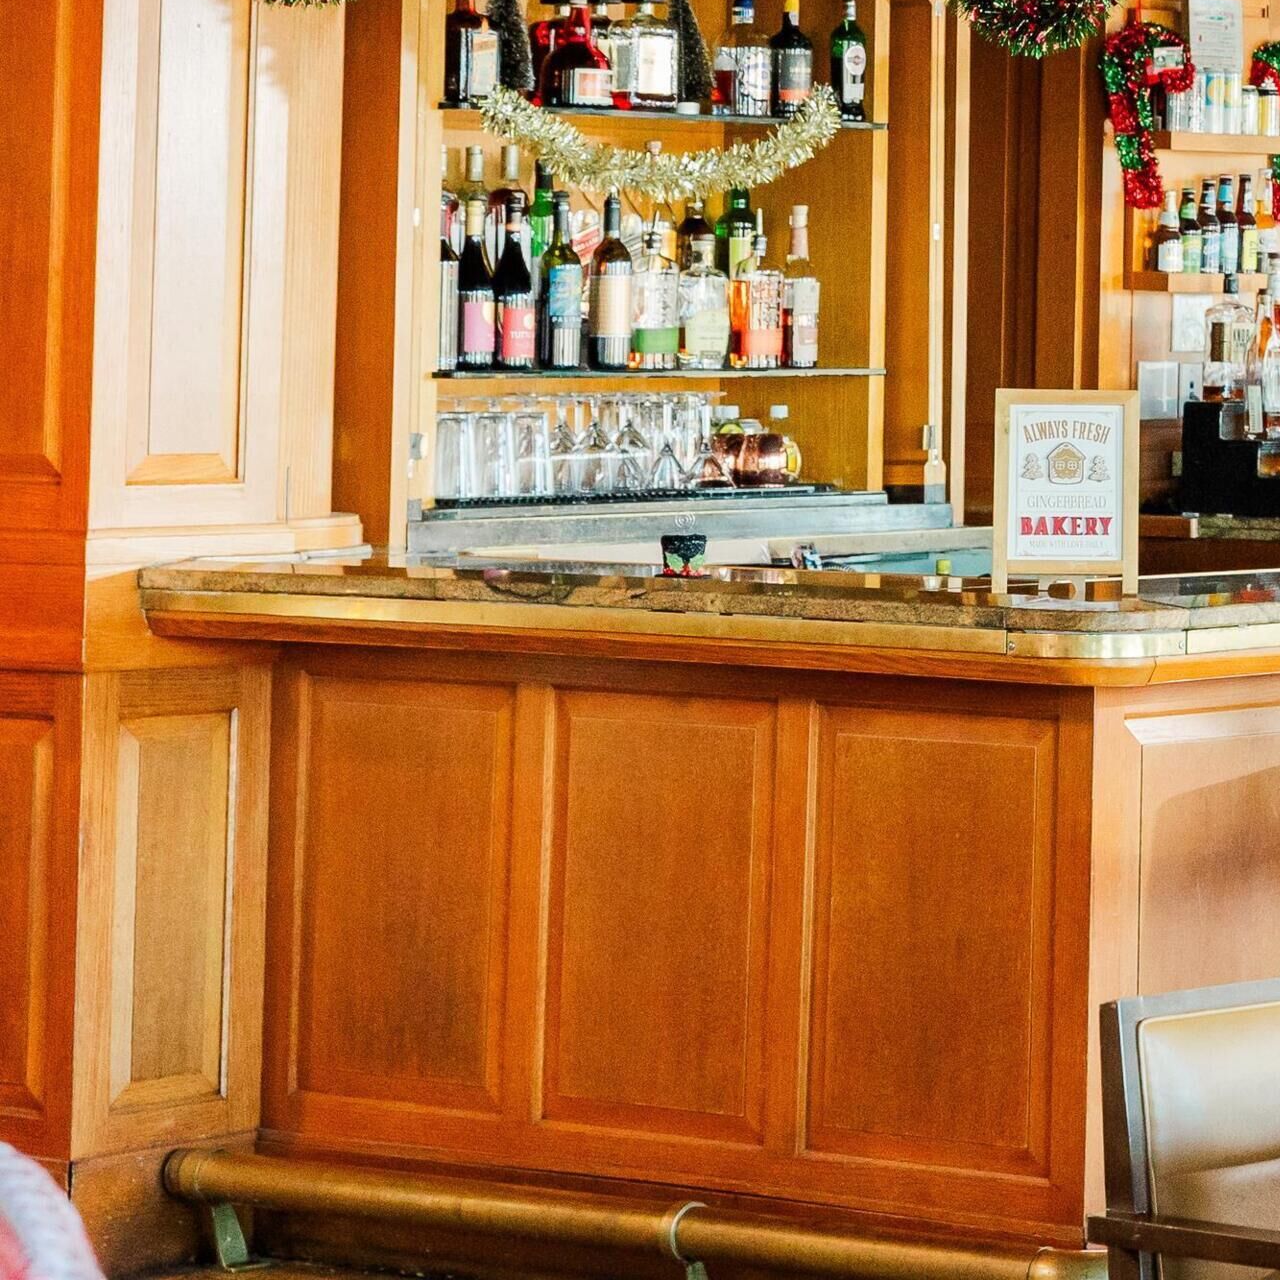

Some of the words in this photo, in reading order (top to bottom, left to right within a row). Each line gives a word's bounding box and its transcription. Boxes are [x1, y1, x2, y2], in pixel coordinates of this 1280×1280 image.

[1023, 420, 1068, 443] ALWAYS
[1072, 420, 1111, 445] FRESH
[1027, 495, 1106, 509] GINGERBREAD
[1020, 516, 1113, 536] BAKERY
